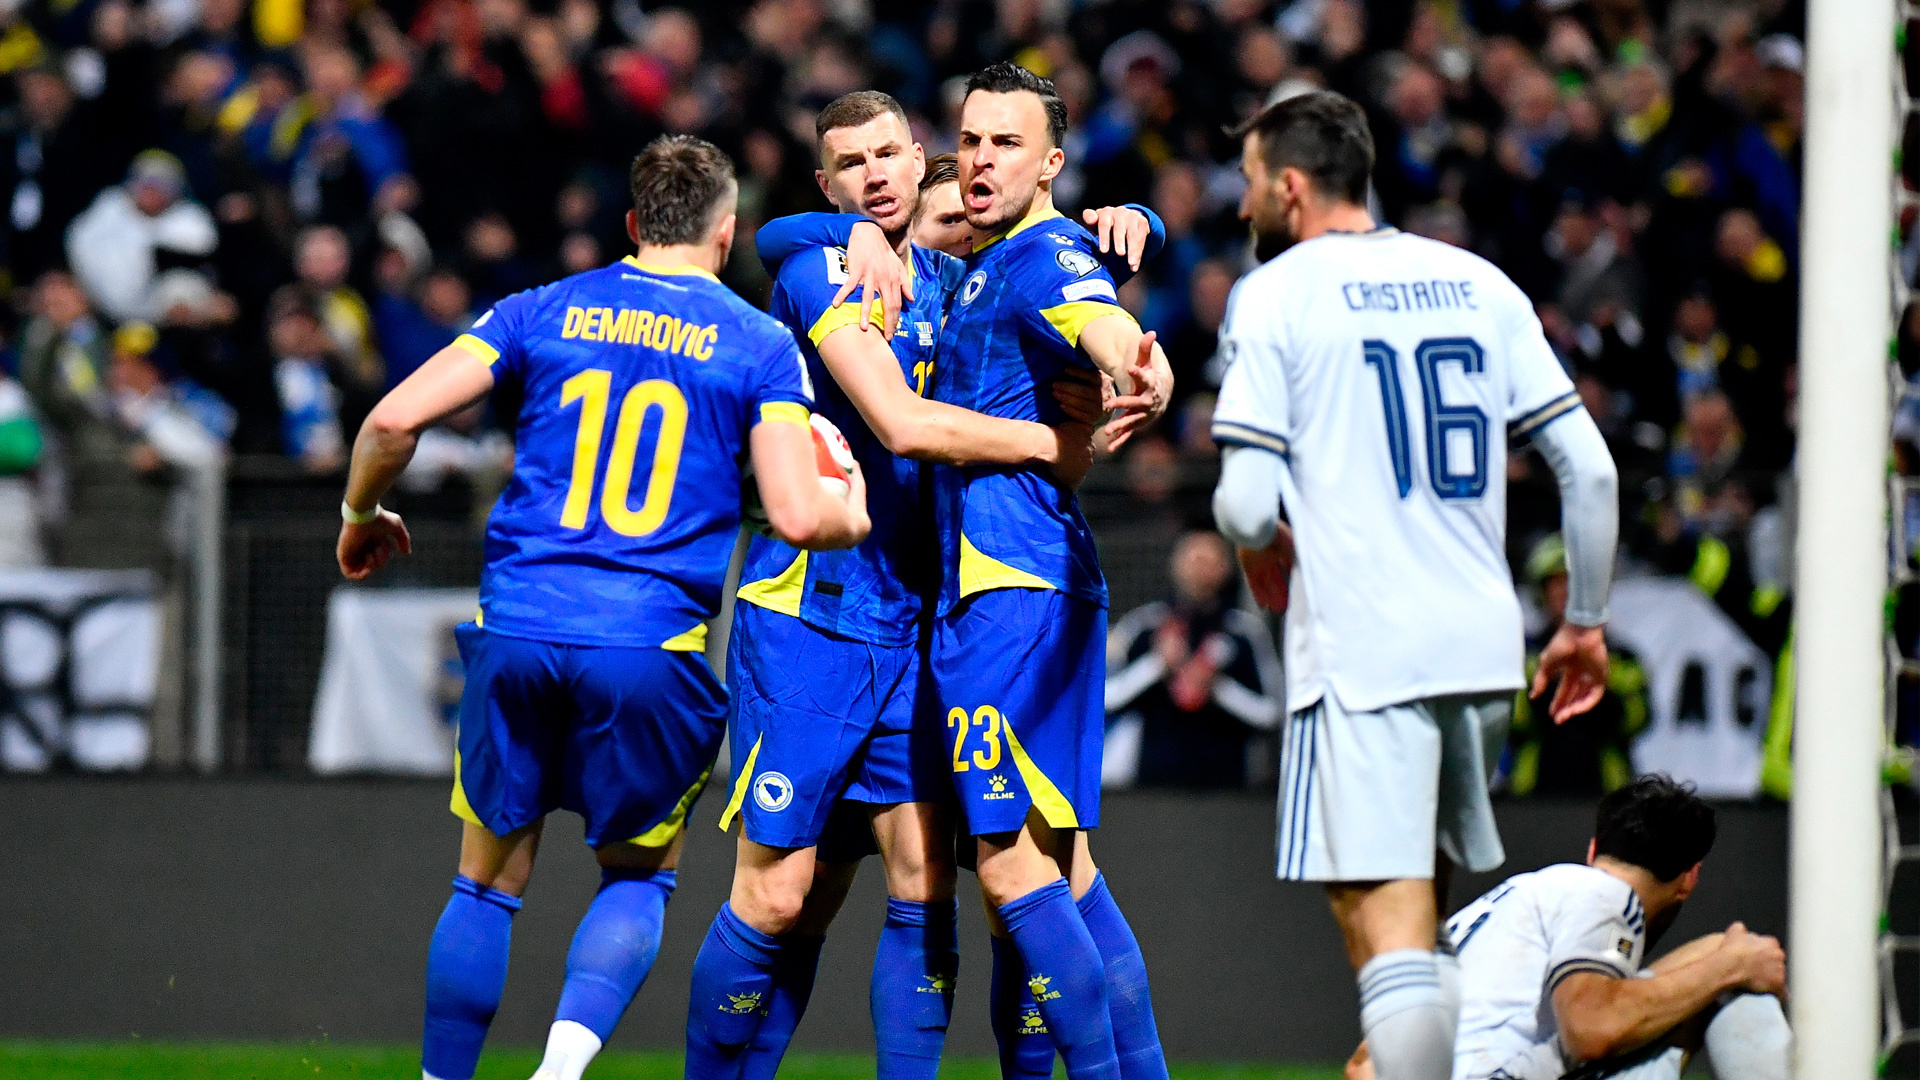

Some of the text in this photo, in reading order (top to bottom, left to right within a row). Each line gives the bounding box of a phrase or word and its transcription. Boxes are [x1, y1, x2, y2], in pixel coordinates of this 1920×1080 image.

[1342, 279, 1478, 312] CRISTANTE
[562, 306, 718, 361] DEMIROVIĆ
[1363, 336, 1489, 499] 16
[559, 368, 689, 537] 10
[947, 704, 1001, 772] 23
[983, 792, 1015, 800] KELME
